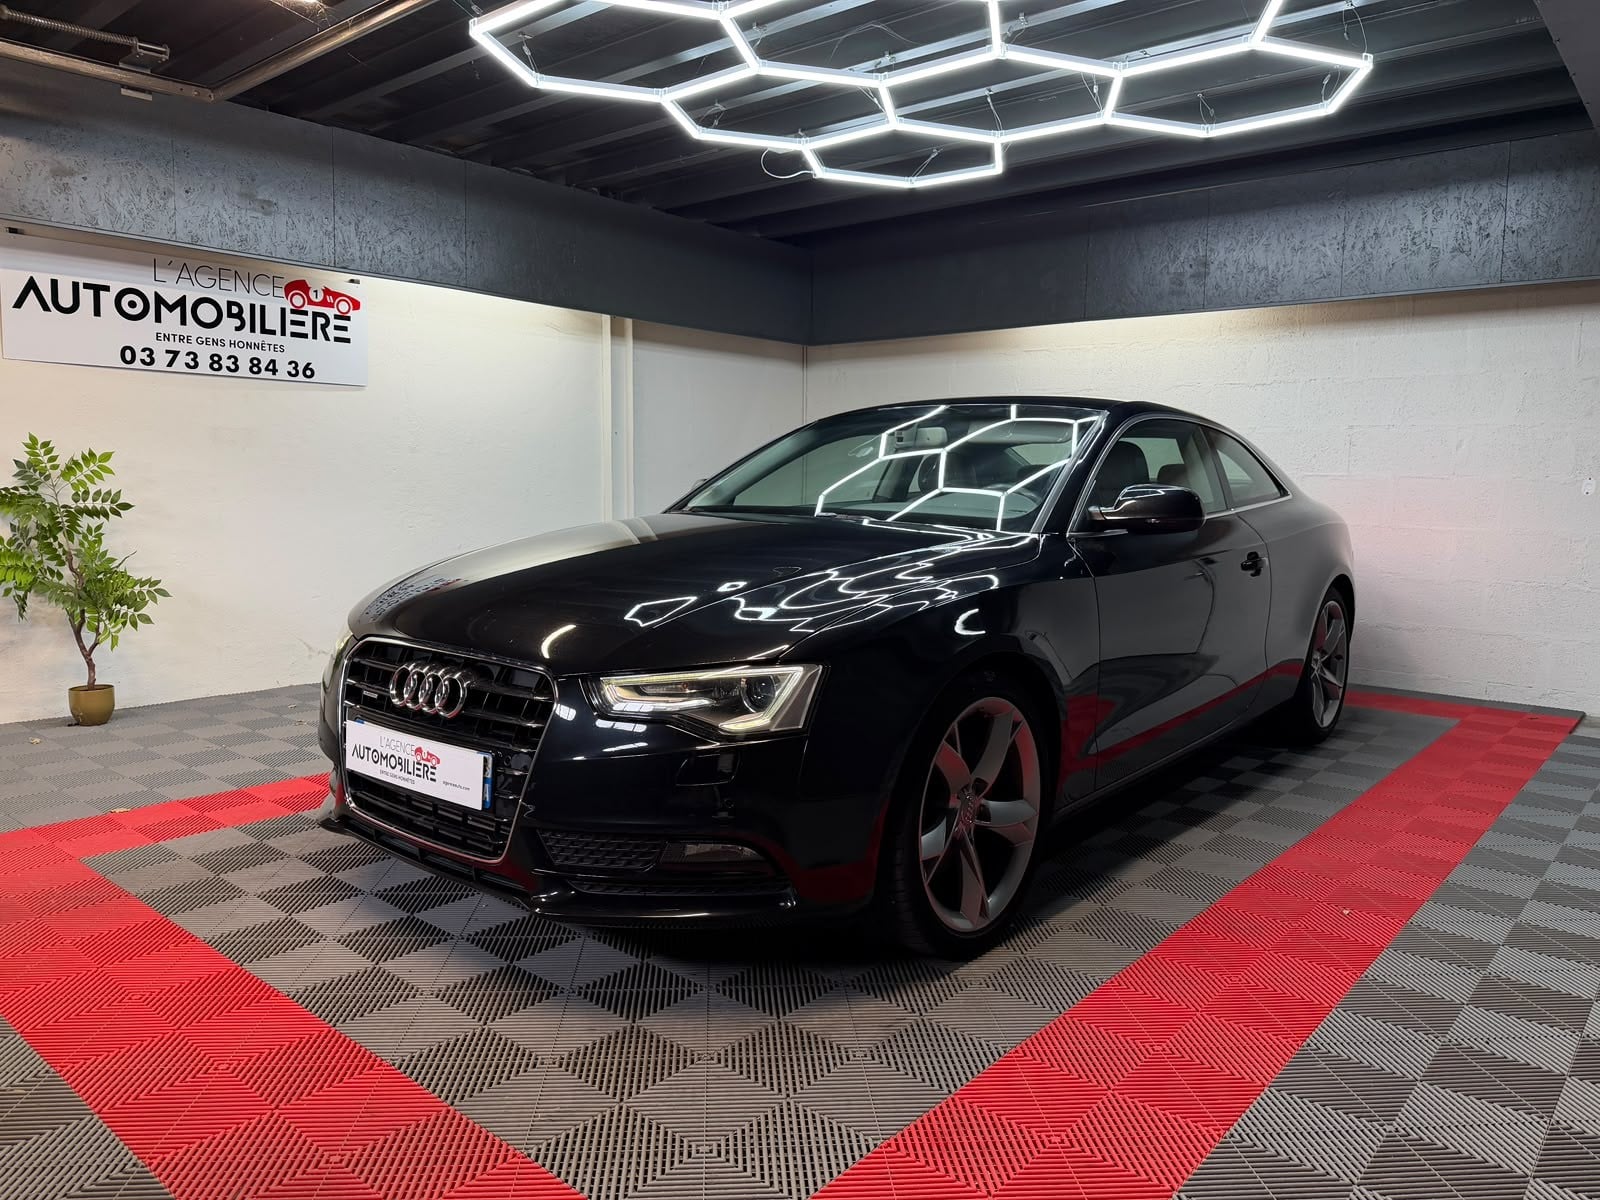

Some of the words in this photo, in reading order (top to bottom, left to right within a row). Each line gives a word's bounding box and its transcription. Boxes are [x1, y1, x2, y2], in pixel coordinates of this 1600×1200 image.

[153, 258, 285, 299] L'AGENCE
[156, 332, 193, 345] ENTRE
[196, 336, 226, 349] GENS
[229, 337, 285, 353] HONNÊTES
[120, 345, 156, 366] 03
[165, 349, 199, 370] 73
[208, 353, 240, 373] 83
[249, 356, 279, 377] 84
[287, 360, 315, 379] 36
